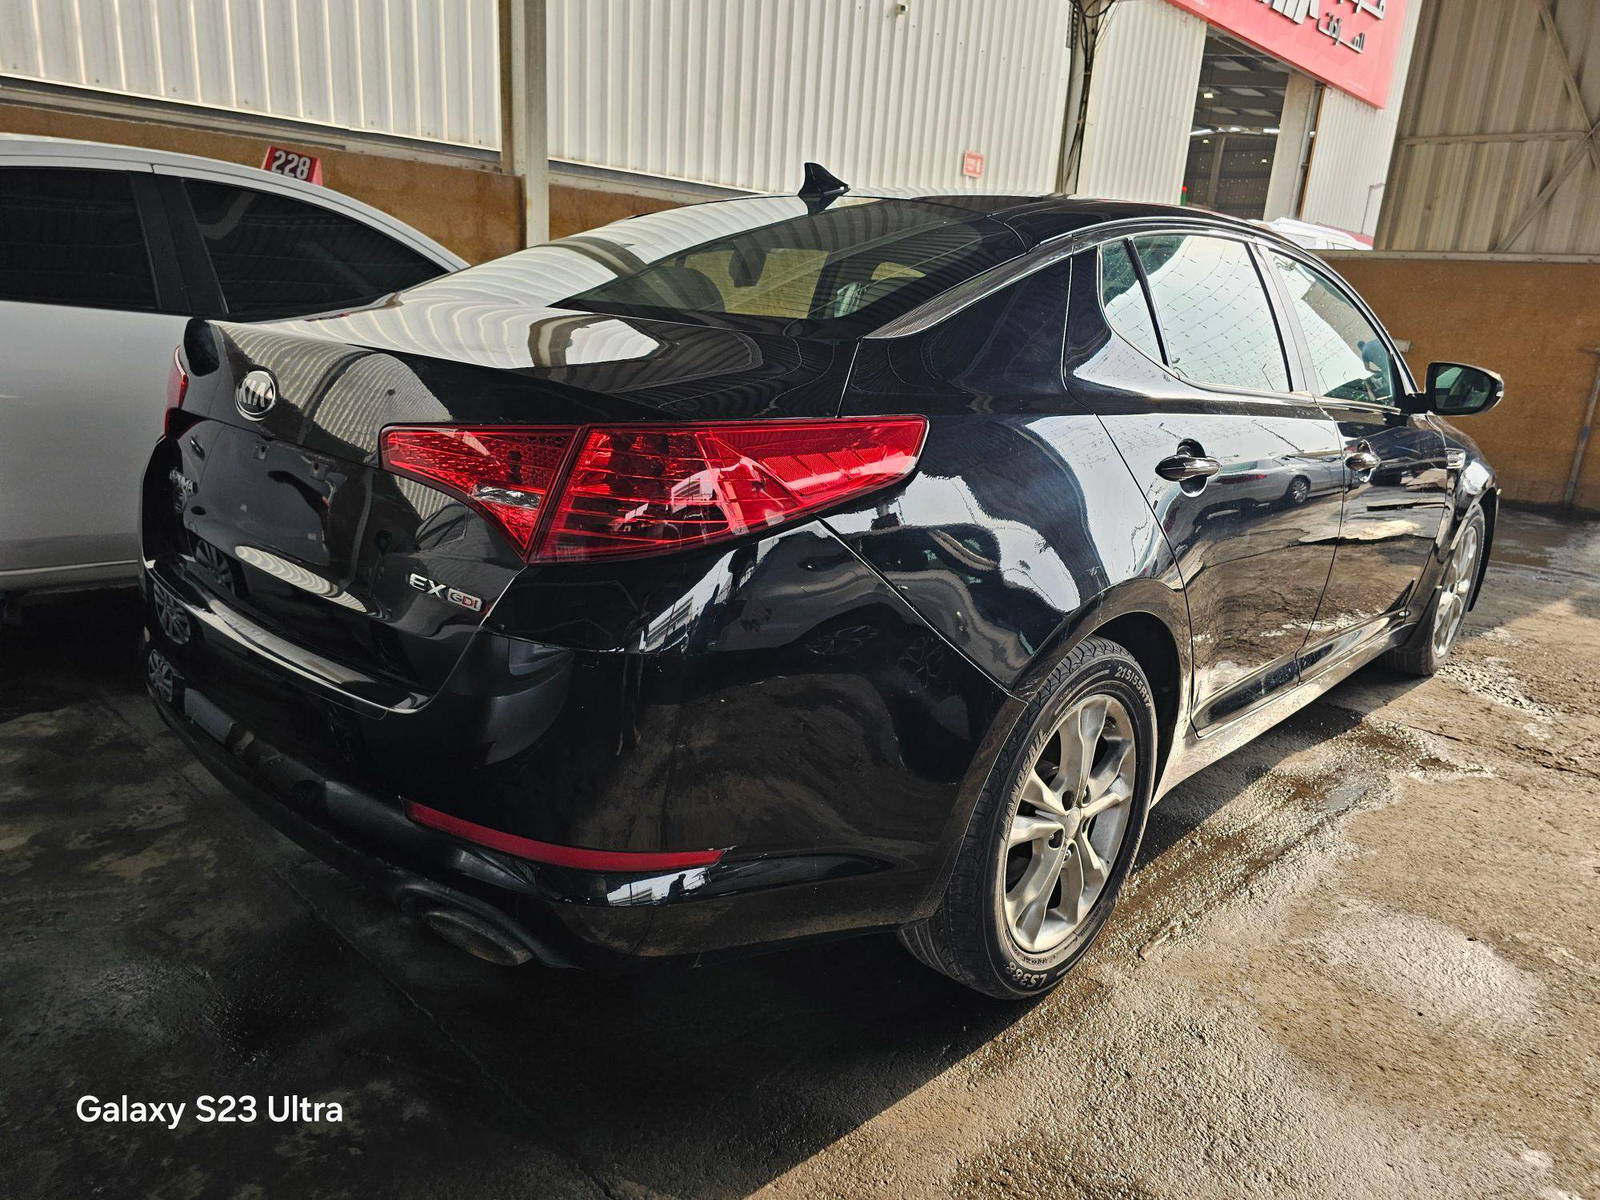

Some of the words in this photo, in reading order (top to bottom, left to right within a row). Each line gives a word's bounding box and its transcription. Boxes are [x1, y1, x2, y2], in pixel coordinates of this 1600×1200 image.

[272, 151, 311, 180] 228
[409, 573, 447, 599] EX
[449, 590, 480, 610] GDI
